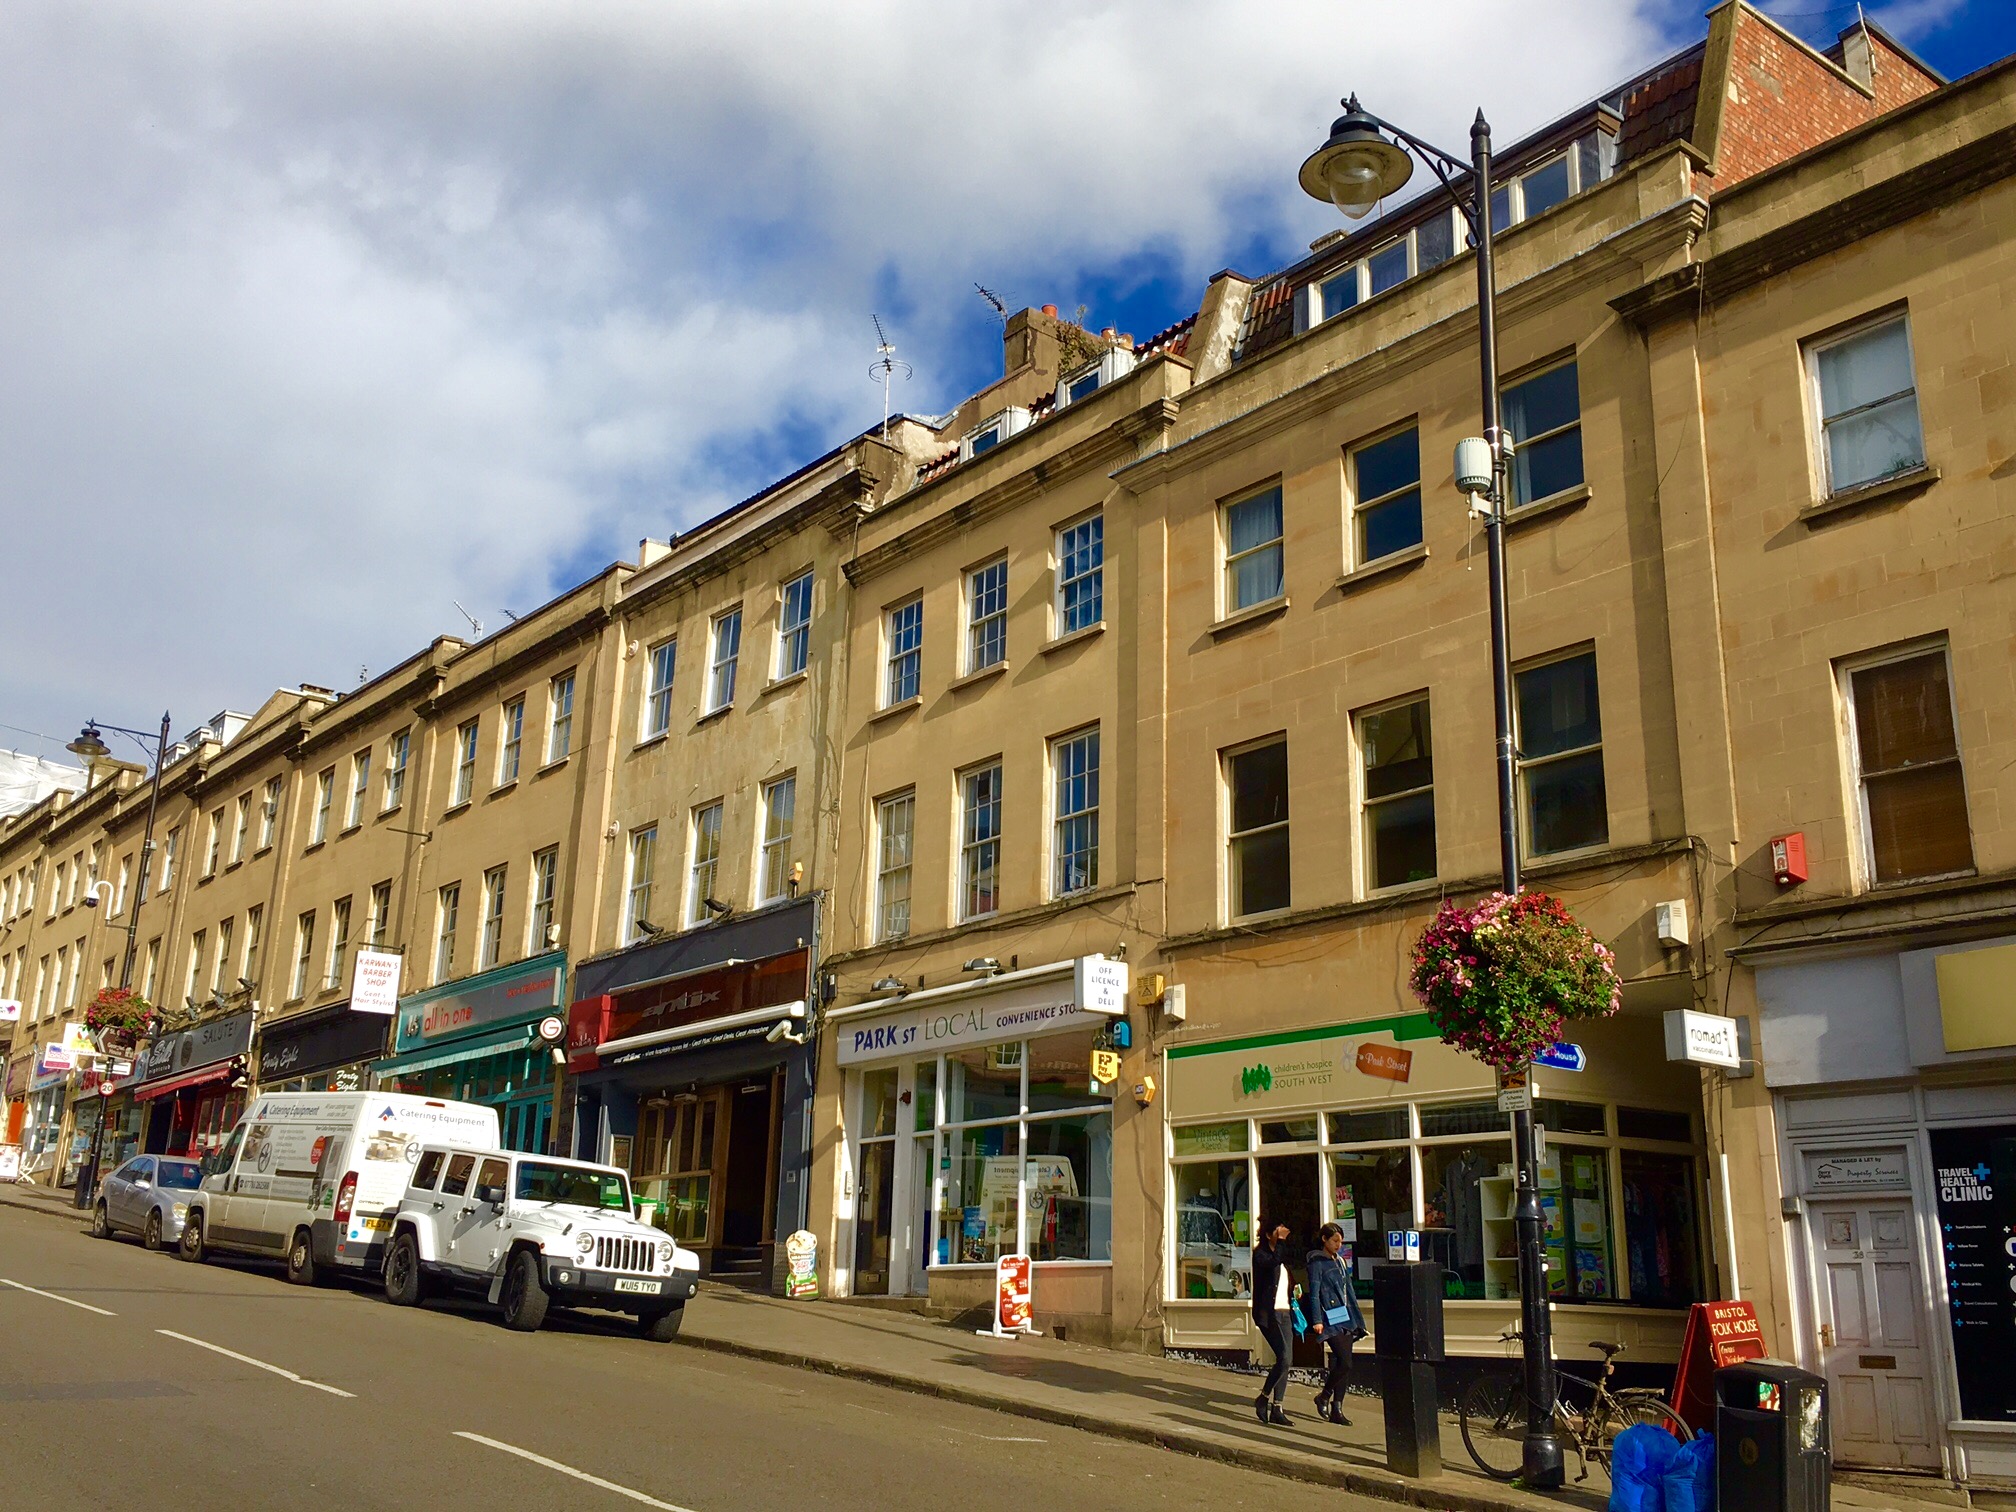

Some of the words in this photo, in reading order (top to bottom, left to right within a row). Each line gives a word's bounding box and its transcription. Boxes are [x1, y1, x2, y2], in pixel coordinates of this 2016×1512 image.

[358, 958, 398, 970] KARWAN'S
[362, 968, 393, 978] BARBER
[1098, 966, 1113, 975] OFF
[366, 978, 387, 987] SHOP
[1091, 976, 1120, 987] LICENCE
[1098, 998, 1115, 1006] DELI
[424, 1007, 438, 1032] all
[440, 1008, 450, 1026] in
[452, 1006, 473, 1025] one
[854, 1024, 898, 1053] PARK
[902, 1026, 917, 1045] ST
[924, 1007, 989, 1041] LOCAL
[996, 1004, 1056, 1028] CONVENIENCE
[1059, 1002, 1083, 1017] STO
[1690, 1028, 1722, 1045] nomad
[1365, 1052, 1385, 1067] Park
[1386, 1056, 1407, 1073] Street
[1554, 1051, 1577, 1062] House
[1274, 1061, 1306, 1074] children's
[1306, 1059, 1333, 1074] hospice
[336, 1069, 359, 1081] Forty
[102, 1084, 113, 1092] 20
[336, 1080, 359, 1092] Eight
[1274, 1076, 1306, 1090] SOUTH
[1308, 1074, 1333, 1086] WEST
[269, 1104, 290, 1116] Catering
[289, 1104, 320, 1118] Equipment
[400, 1108, 437, 1122] Catering
[438, 1114, 485, 1127] Equipment
[1847, 1169, 1872, 1178] Property
[1938, 1167, 1973, 1178] TRAVEL
[1940, 1176, 1978, 1187] HEALTH
[1941, 1186, 1993, 1202] CLINIC
[1392, 1233, 1400, 1246] P
[1409, 1234, 1417, 1246] P
[619, 1279, 639, 1291] WU15
[1714, 1306, 1748, 1319] BRISTOL
[1711, 1322, 1734, 1336] FOLK
[1733, 1319, 1759, 1334] HOUSE
